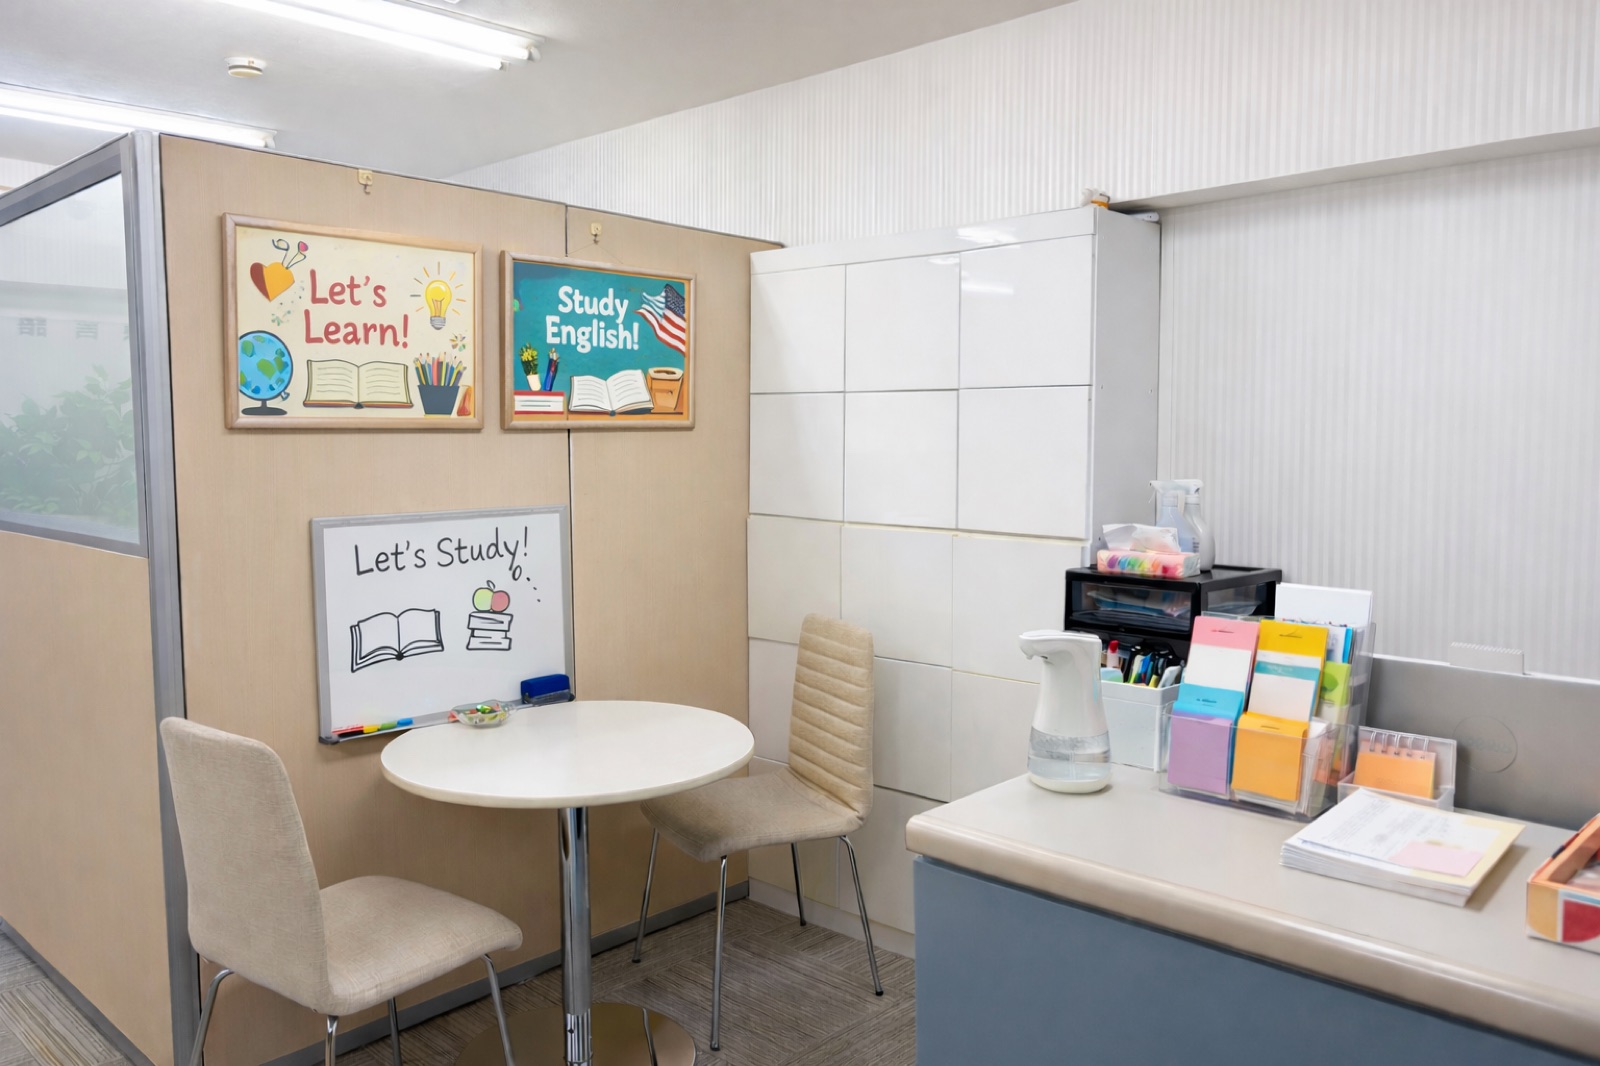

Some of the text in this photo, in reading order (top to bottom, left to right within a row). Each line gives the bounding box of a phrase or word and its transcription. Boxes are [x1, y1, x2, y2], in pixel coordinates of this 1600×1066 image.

[309, 269, 387, 308] Let's
[557, 285, 630, 326] Study
[303, 308, 409, 349] Learn!
[545, 314, 640, 353] English!
[354, 526, 529, 576] Let's Study!
